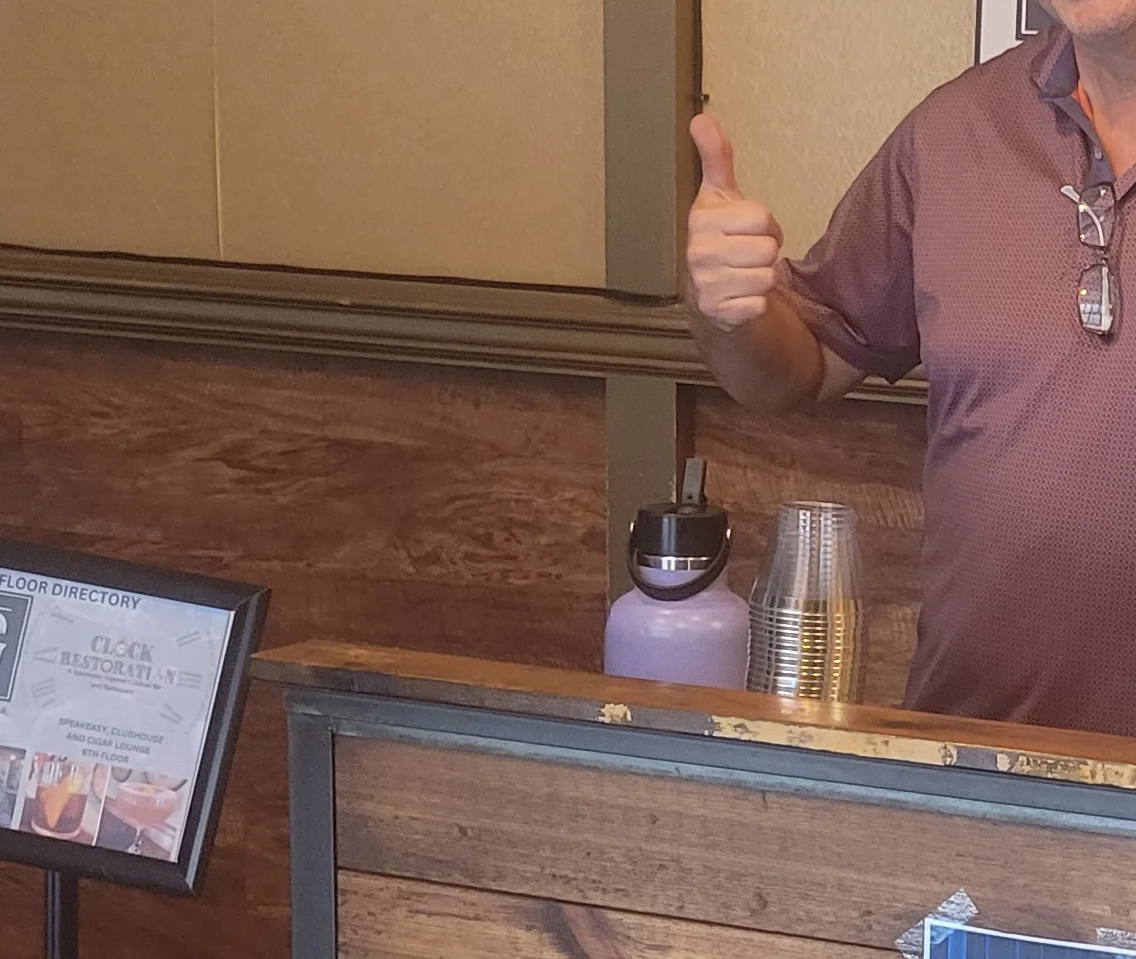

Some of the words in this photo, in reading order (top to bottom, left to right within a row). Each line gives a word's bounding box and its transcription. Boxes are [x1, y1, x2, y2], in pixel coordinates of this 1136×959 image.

[0, 574, 48, 594] FLOOR
[52, 583, 142, 610] DIRECTORY
[66, 732, 86, 743] AND
[87, 735, 113, 747] CIGAR
[115, 741, 151, 755] LOUNGE
[111, 727, 164, 744] CLUBHOUSE
[101, 751, 130, 763] FLOOR
